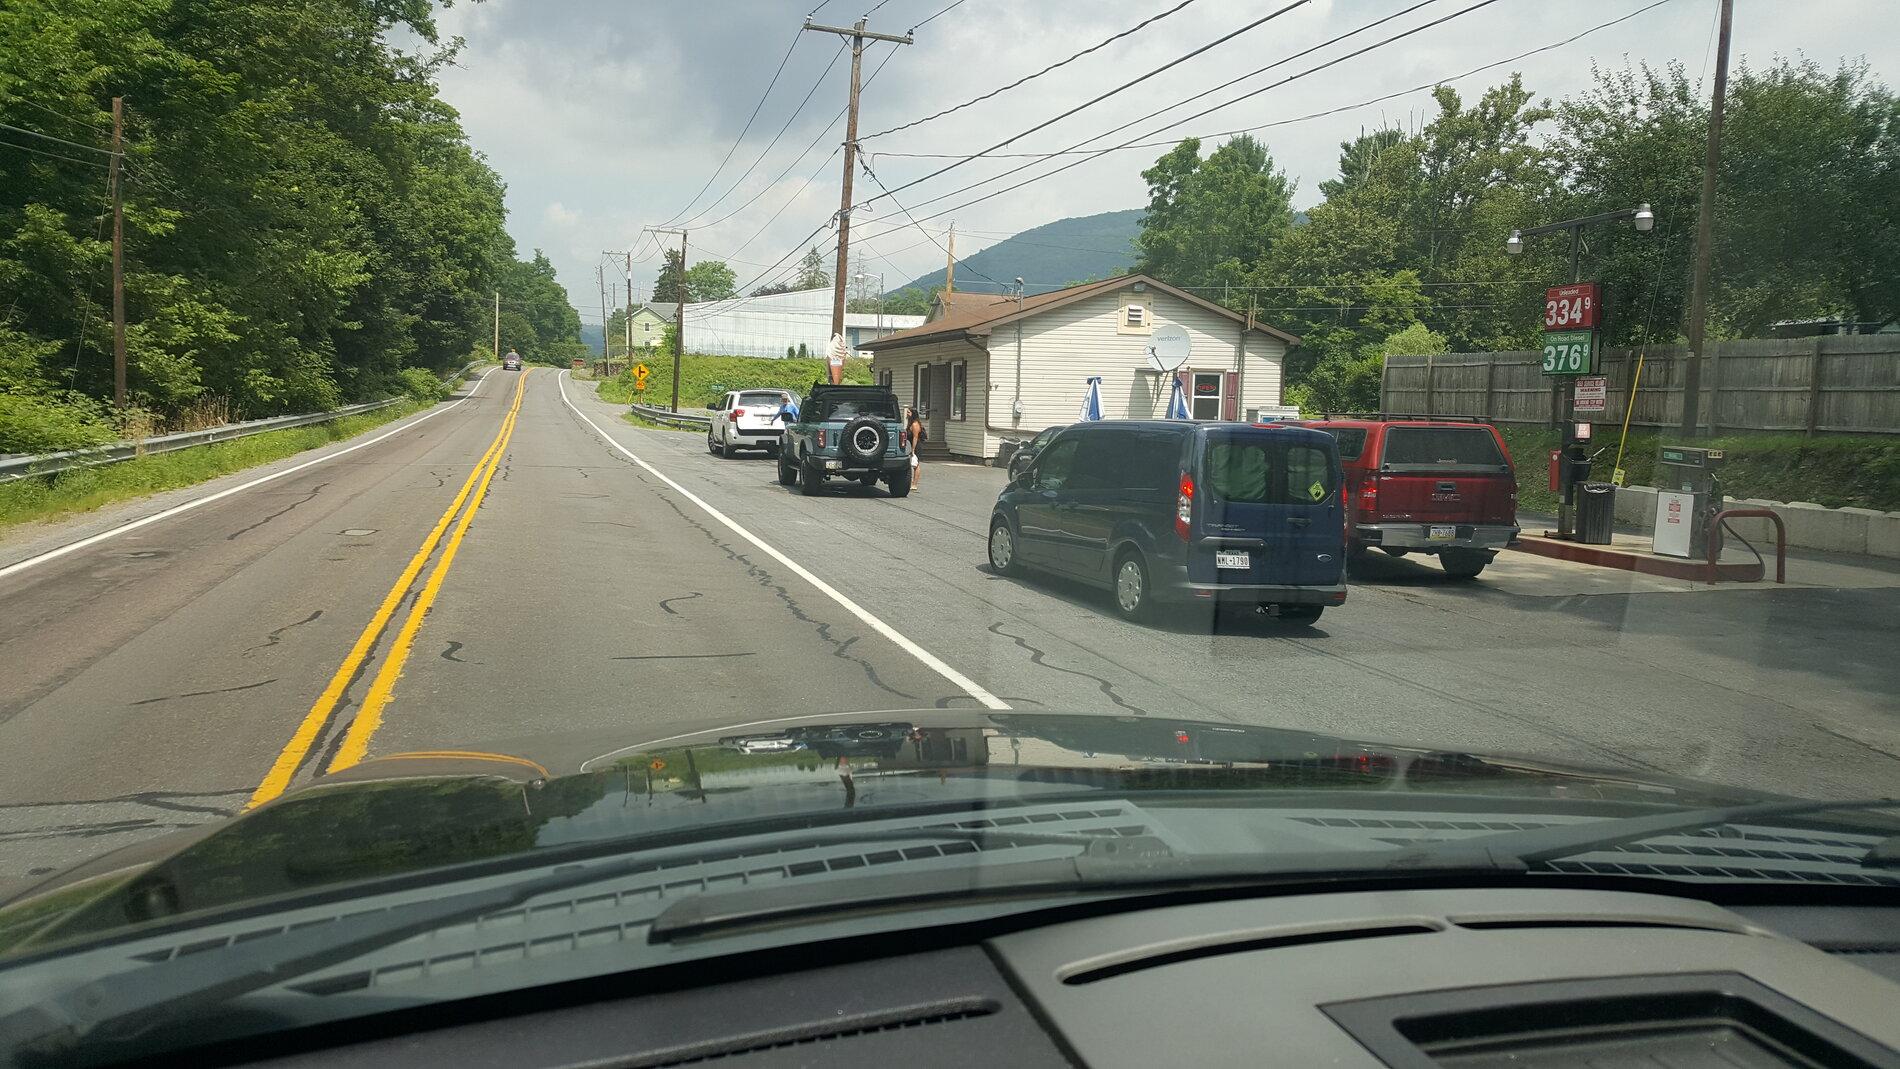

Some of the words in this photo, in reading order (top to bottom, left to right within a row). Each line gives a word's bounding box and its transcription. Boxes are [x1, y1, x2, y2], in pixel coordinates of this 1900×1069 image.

[1559, 288, 1579, 296] Unleaded
[1545, 297, 1582, 326] 334
[1584, 297, 1591, 310] 9
[1543, 344, 1582, 372] 376
[1583, 344, 1589, 357] 9
